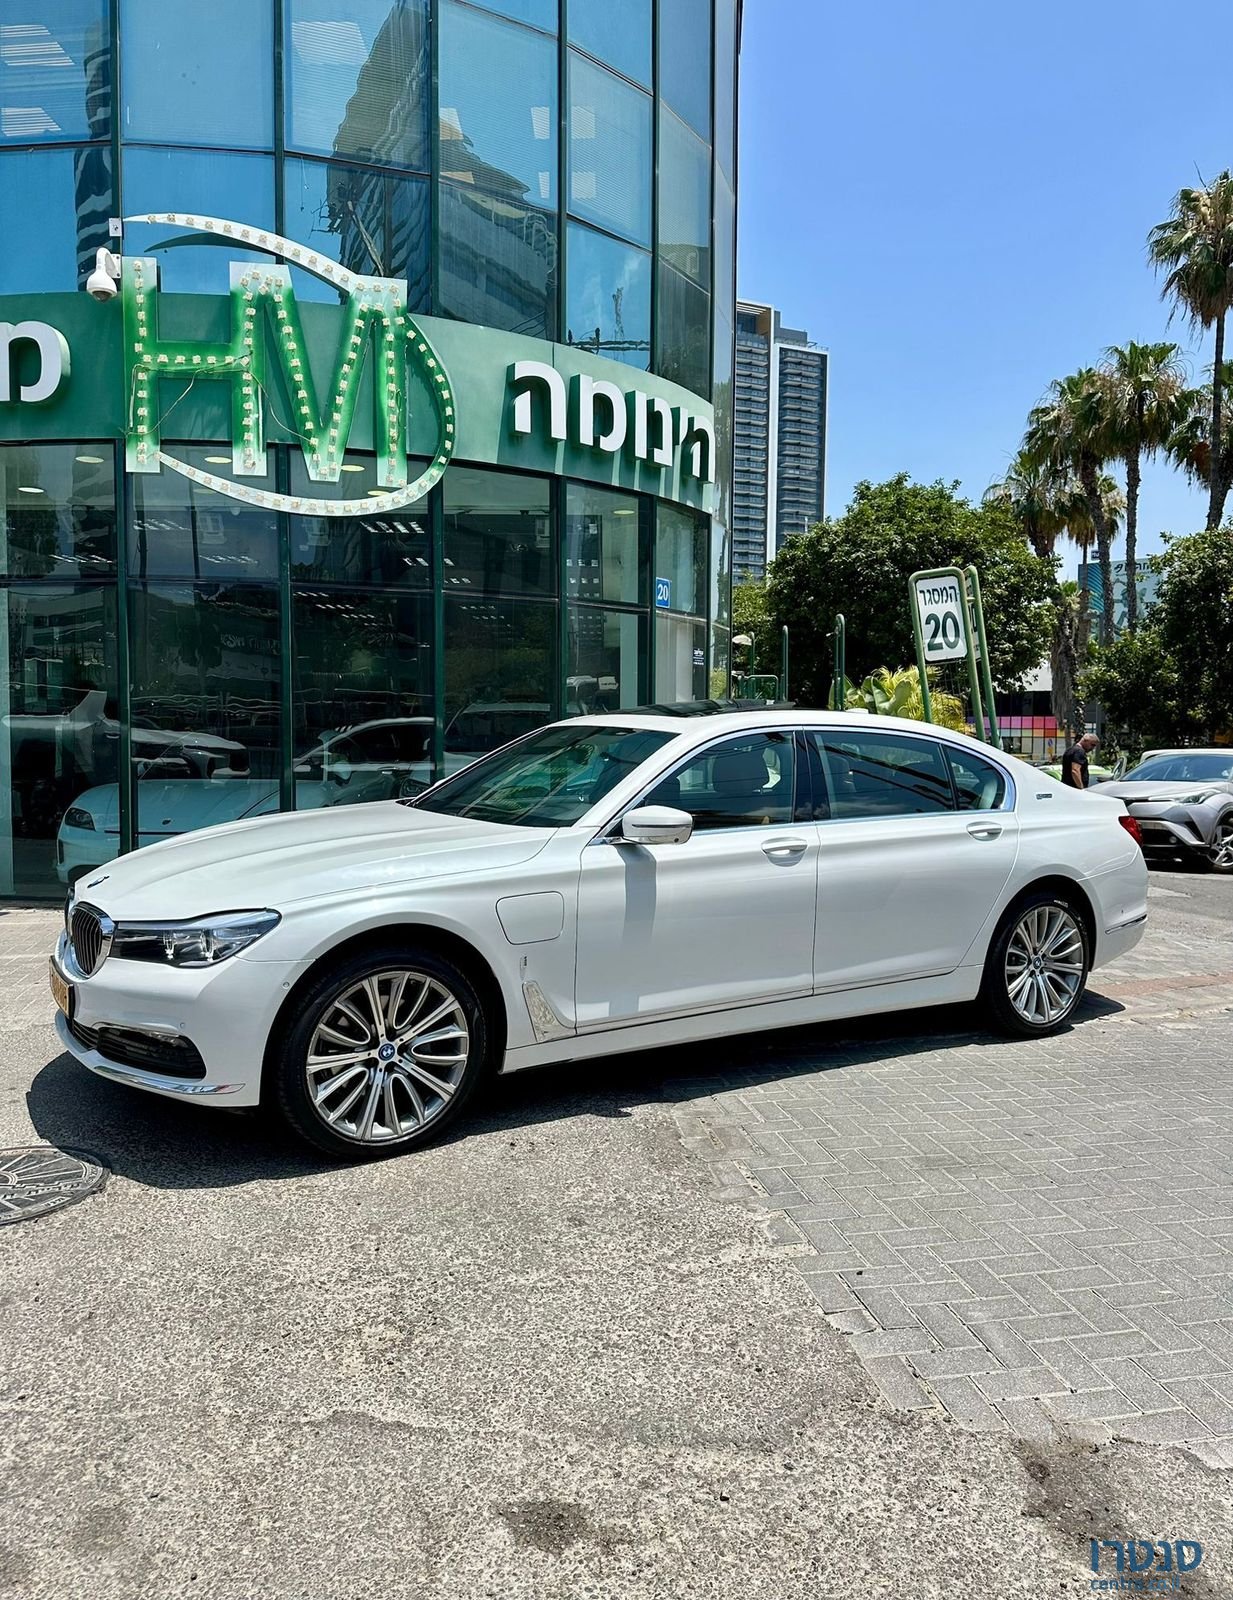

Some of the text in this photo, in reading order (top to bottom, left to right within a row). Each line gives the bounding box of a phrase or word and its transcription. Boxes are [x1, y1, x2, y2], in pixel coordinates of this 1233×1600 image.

[511, 360, 716, 484] הינומה
[657, 583, 669, 601] 20
[919, 585, 959, 606] המסגר
[924, 611, 960, 651] 20
